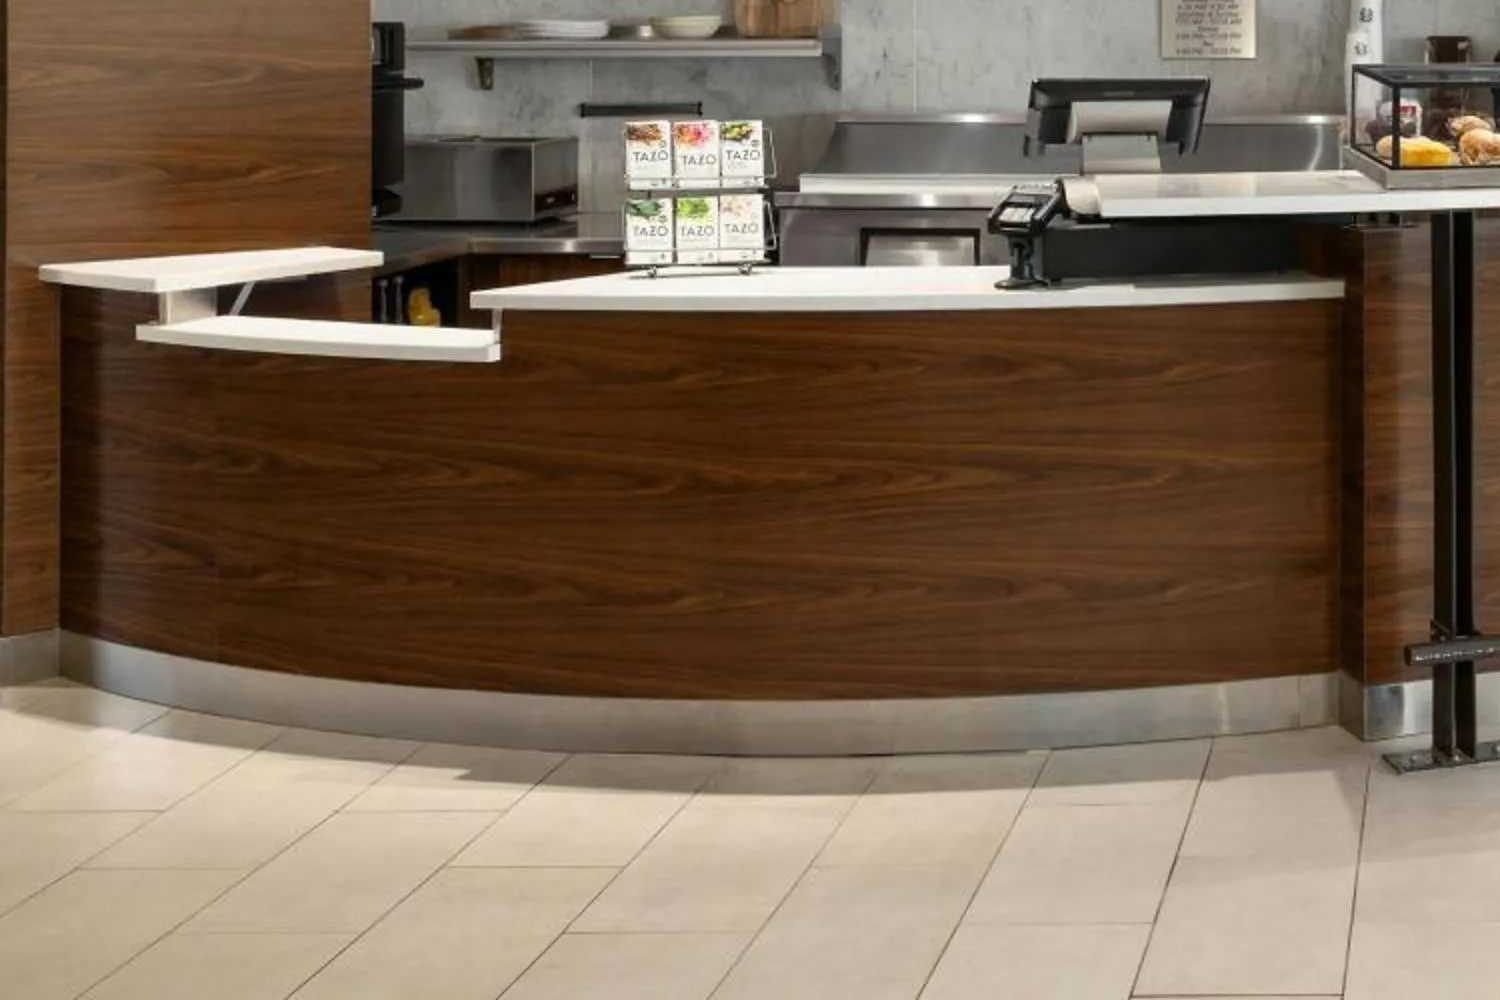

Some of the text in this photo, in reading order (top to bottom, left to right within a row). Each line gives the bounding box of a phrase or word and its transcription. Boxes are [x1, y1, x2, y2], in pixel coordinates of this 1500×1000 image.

[632, 149, 668, 162] TAZO
[682, 153, 717, 166] TAZO
[726, 149, 761, 161] TAZO
[633, 225, 669, 237] TAZO
[680, 225, 715, 236] TAZO
[724, 222, 758, 234] TAZO
